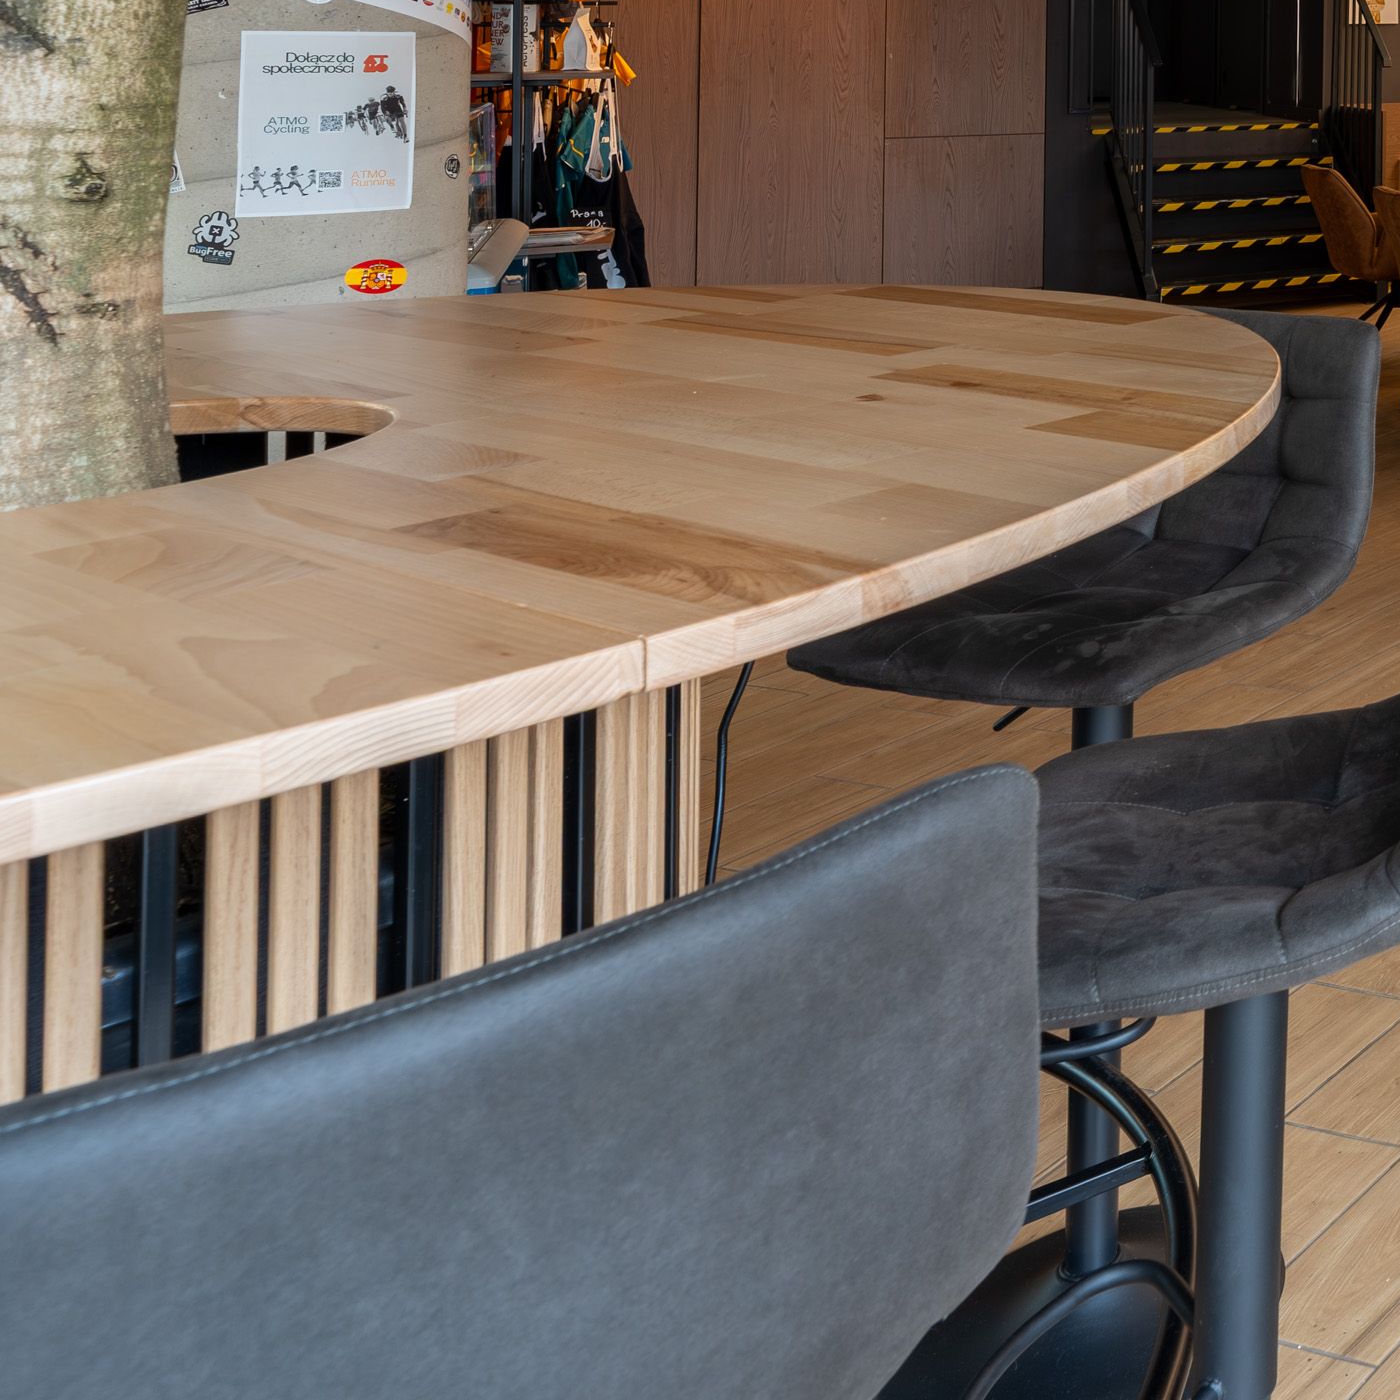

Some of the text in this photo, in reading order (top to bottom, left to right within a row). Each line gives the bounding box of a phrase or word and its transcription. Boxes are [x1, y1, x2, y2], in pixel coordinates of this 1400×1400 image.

[285, 52, 355, 65] Dołącz do
[262, 64, 355, 76] społeczności
[268, 116, 308, 125] ATMO
[263, 125, 310, 135] Cycling
[351, 169, 387, 178] ATMO
[351, 178, 397, 188] Running
[189, 245, 233, 258] BugFree
